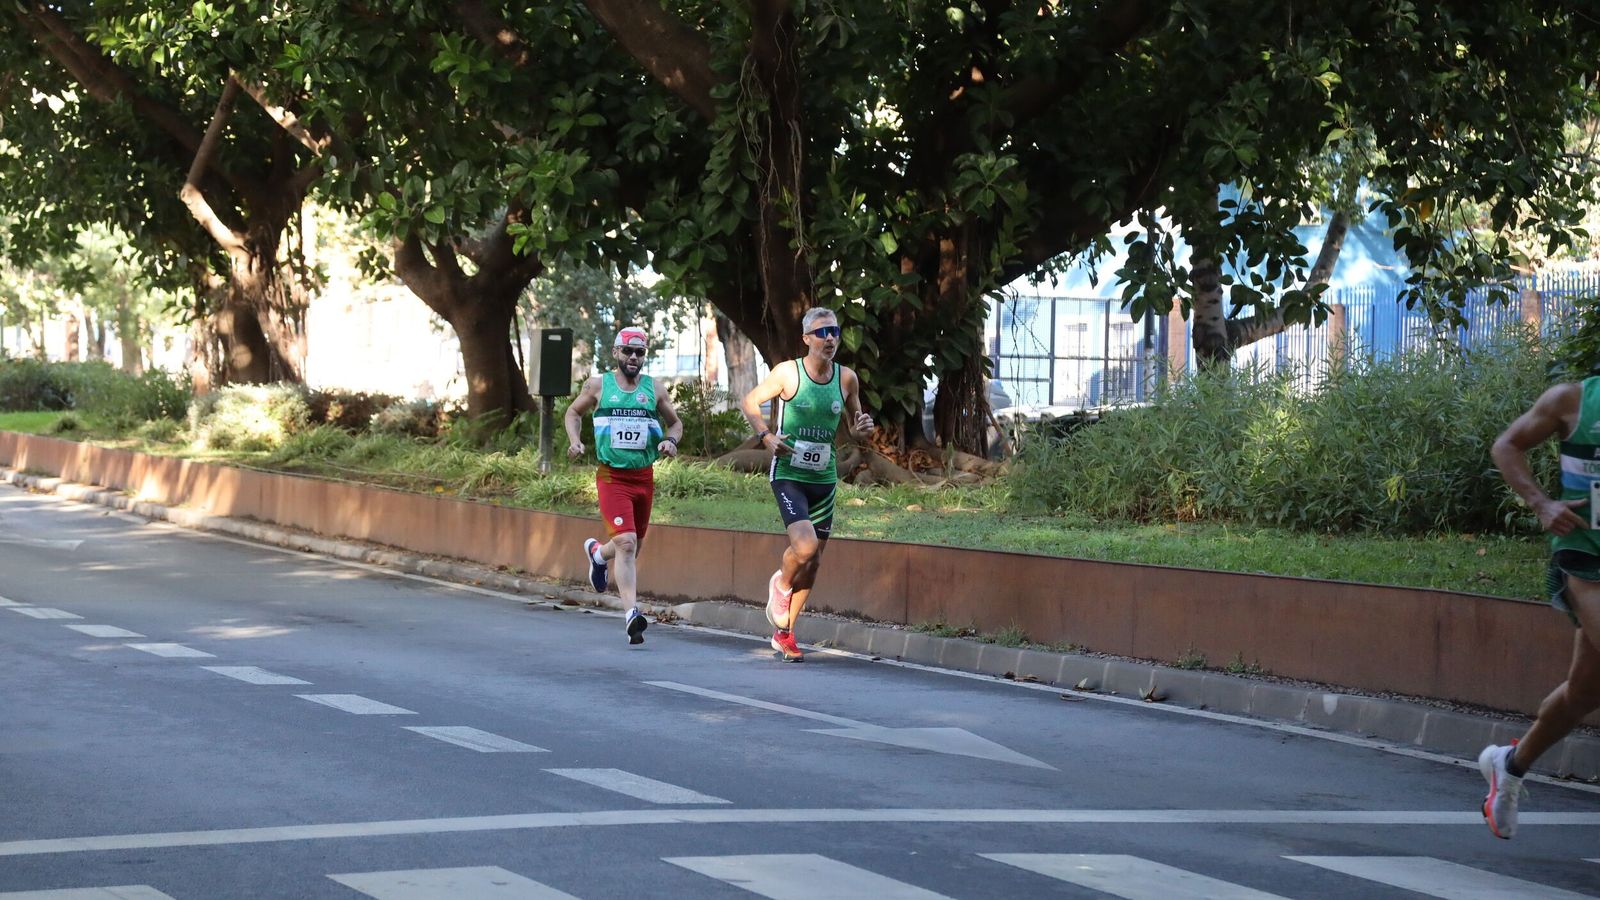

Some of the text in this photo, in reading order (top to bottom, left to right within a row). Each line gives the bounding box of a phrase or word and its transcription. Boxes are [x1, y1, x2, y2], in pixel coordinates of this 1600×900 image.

[611, 408, 647, 417] ATLETISMO
[616, 430, 641, 441] 107
[803, 452, 820, 463] 90
